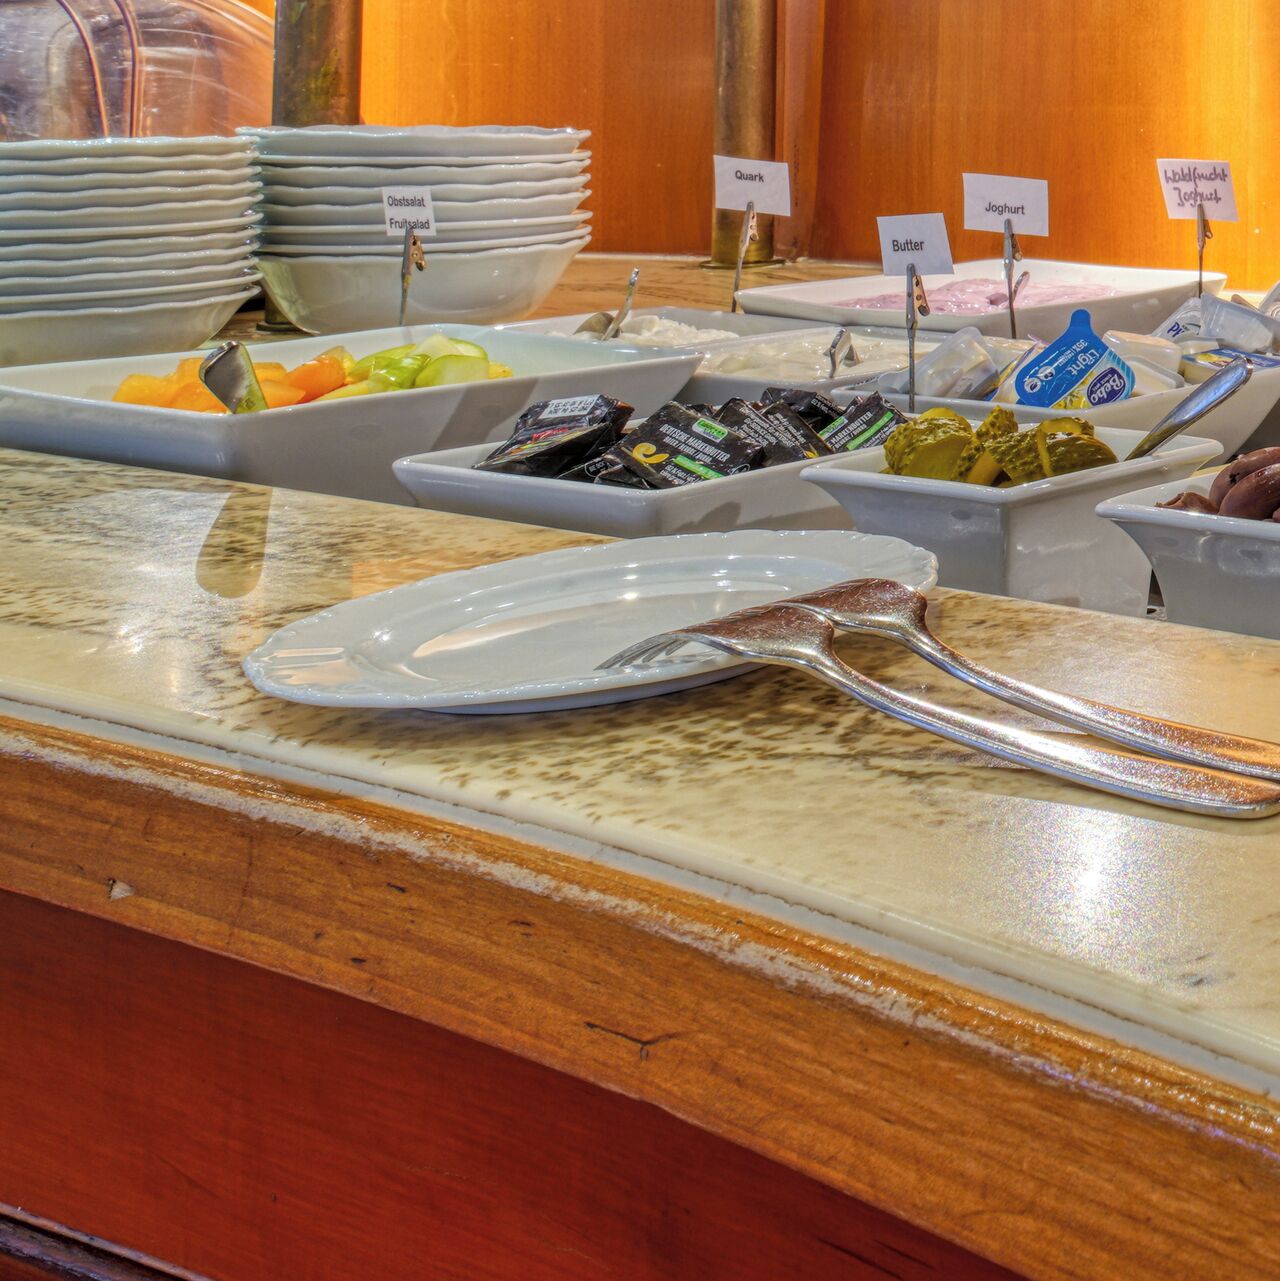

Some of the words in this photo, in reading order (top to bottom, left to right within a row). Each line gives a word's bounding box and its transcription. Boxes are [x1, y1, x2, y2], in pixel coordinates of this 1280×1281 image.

[734, 169, 765, 183] Quark
[387, 195, 426, 207] Obstsalat
[985, 201, 1025, 217] Joghurt
[389, 217, 430, 229] Fruitsalad
[892, 239, 925, 252] Butter
